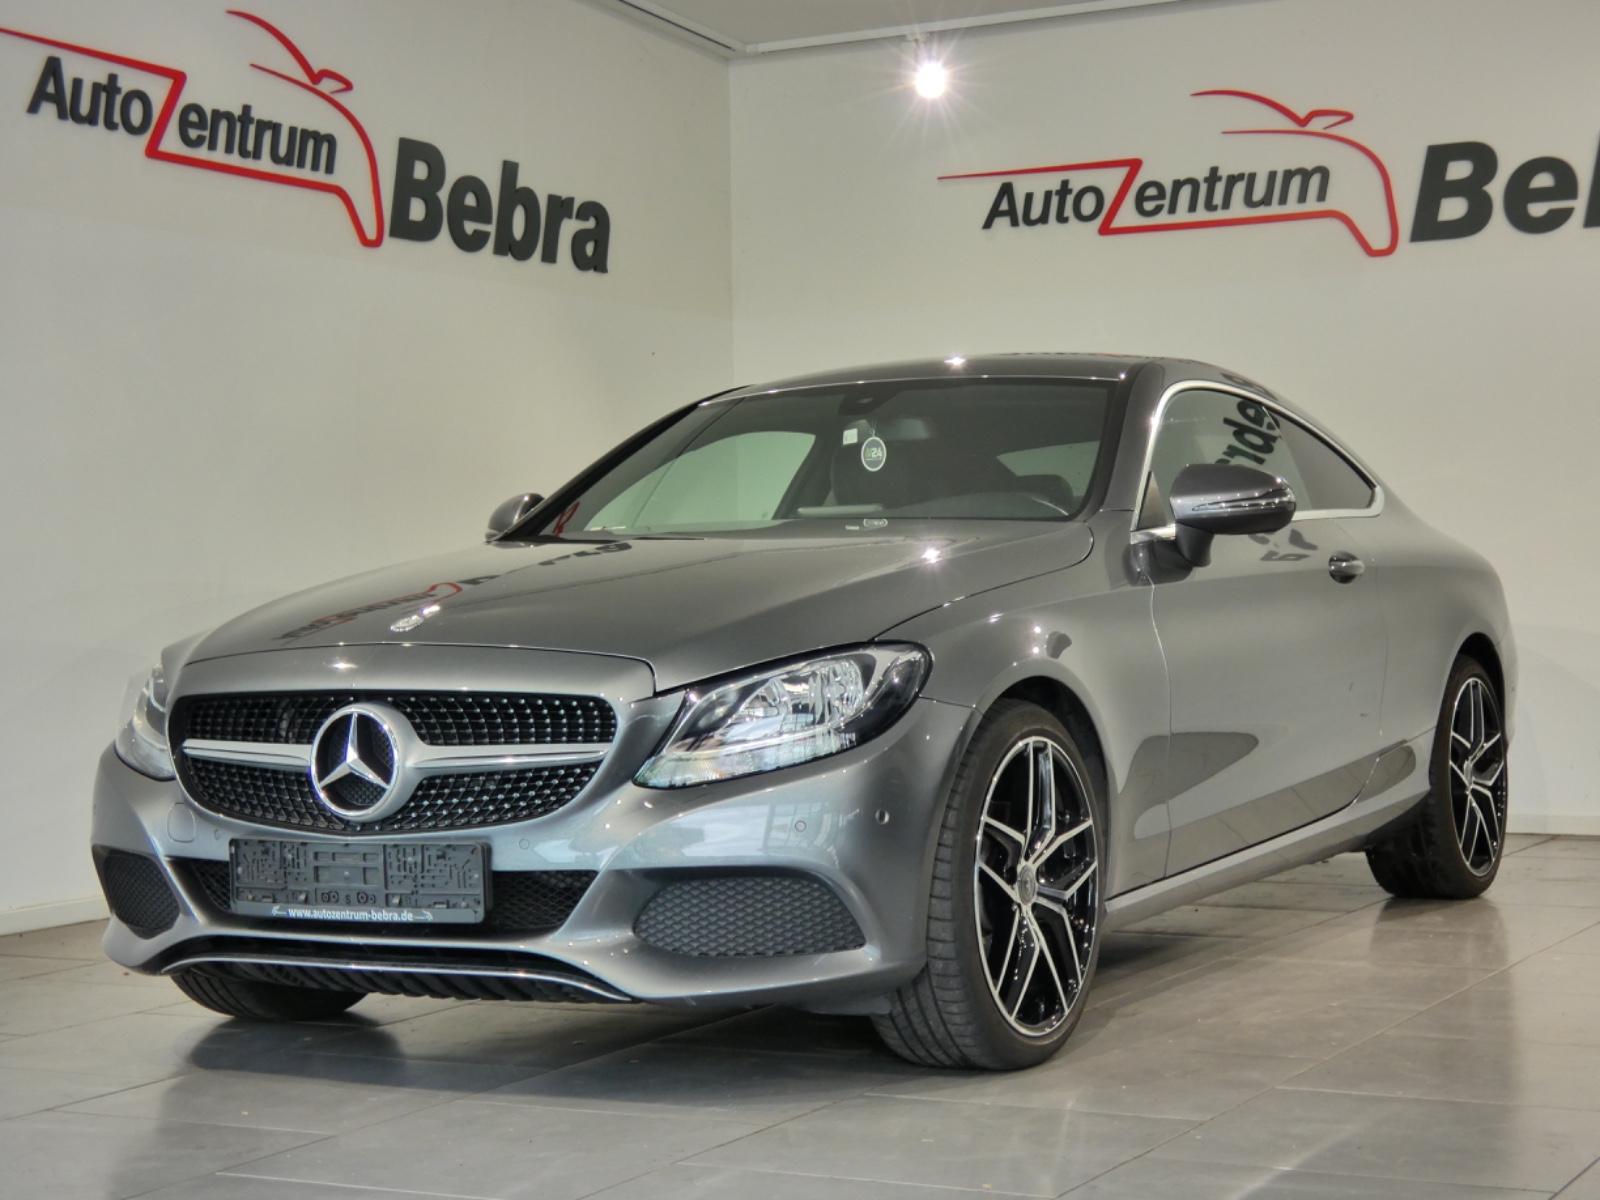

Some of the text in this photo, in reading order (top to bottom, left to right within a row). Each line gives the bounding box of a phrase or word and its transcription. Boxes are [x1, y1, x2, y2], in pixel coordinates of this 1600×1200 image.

[389, 138, 611, 274] Bebra
[1410, 141, 1600, 243] Be
[288, 908, 414, 922] www.autozentrum-bebra.de
